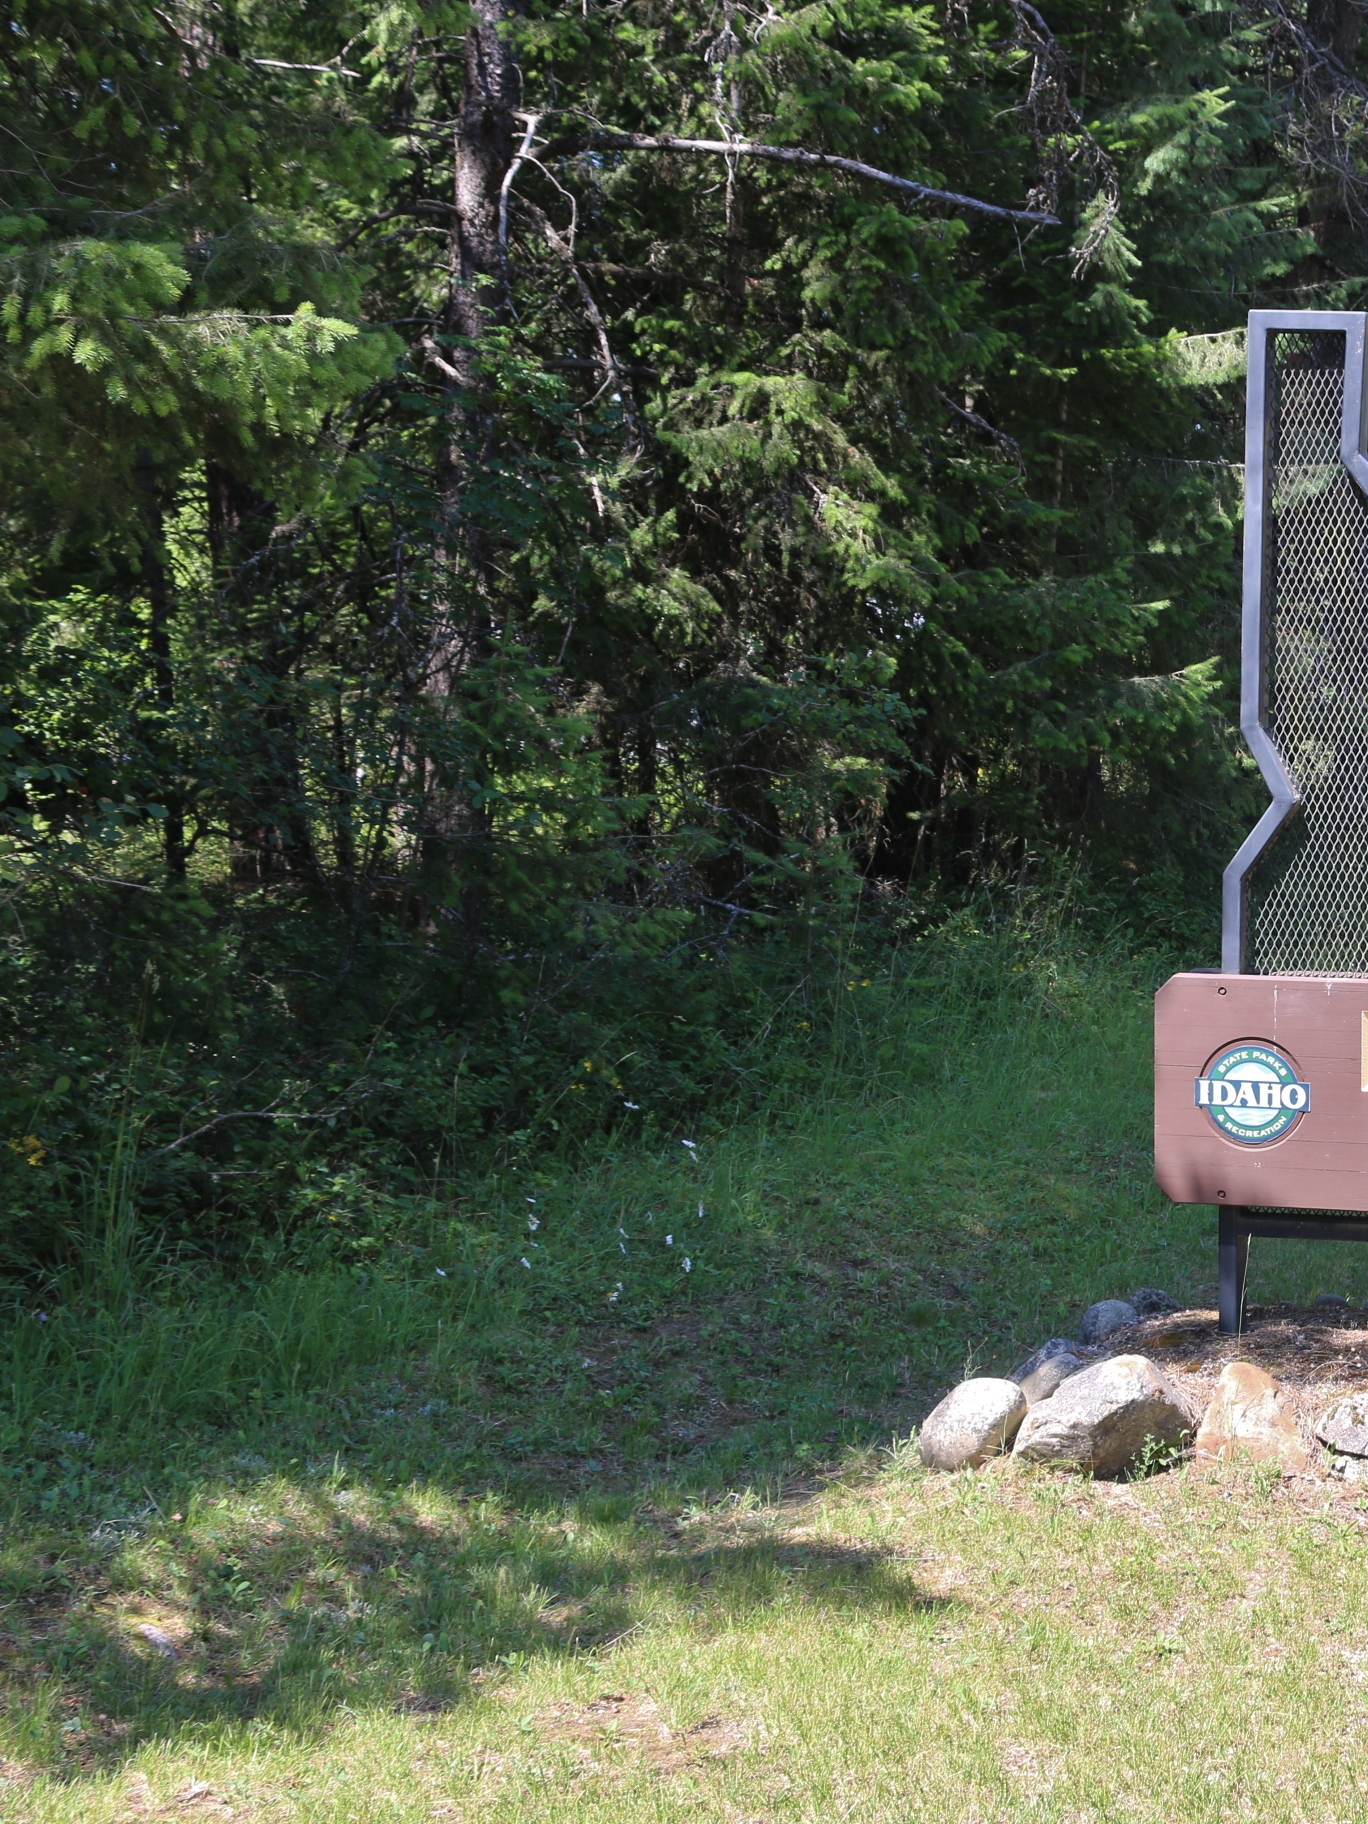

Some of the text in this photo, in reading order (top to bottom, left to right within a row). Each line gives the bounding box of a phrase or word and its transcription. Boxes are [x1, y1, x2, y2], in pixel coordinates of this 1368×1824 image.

[1218, 1051, 1288, 1077] STATE PARKS
[1198, 1080, 1307, 1110] IDAHO
[1217, 1114, 1287, 1138] & RECREATION
